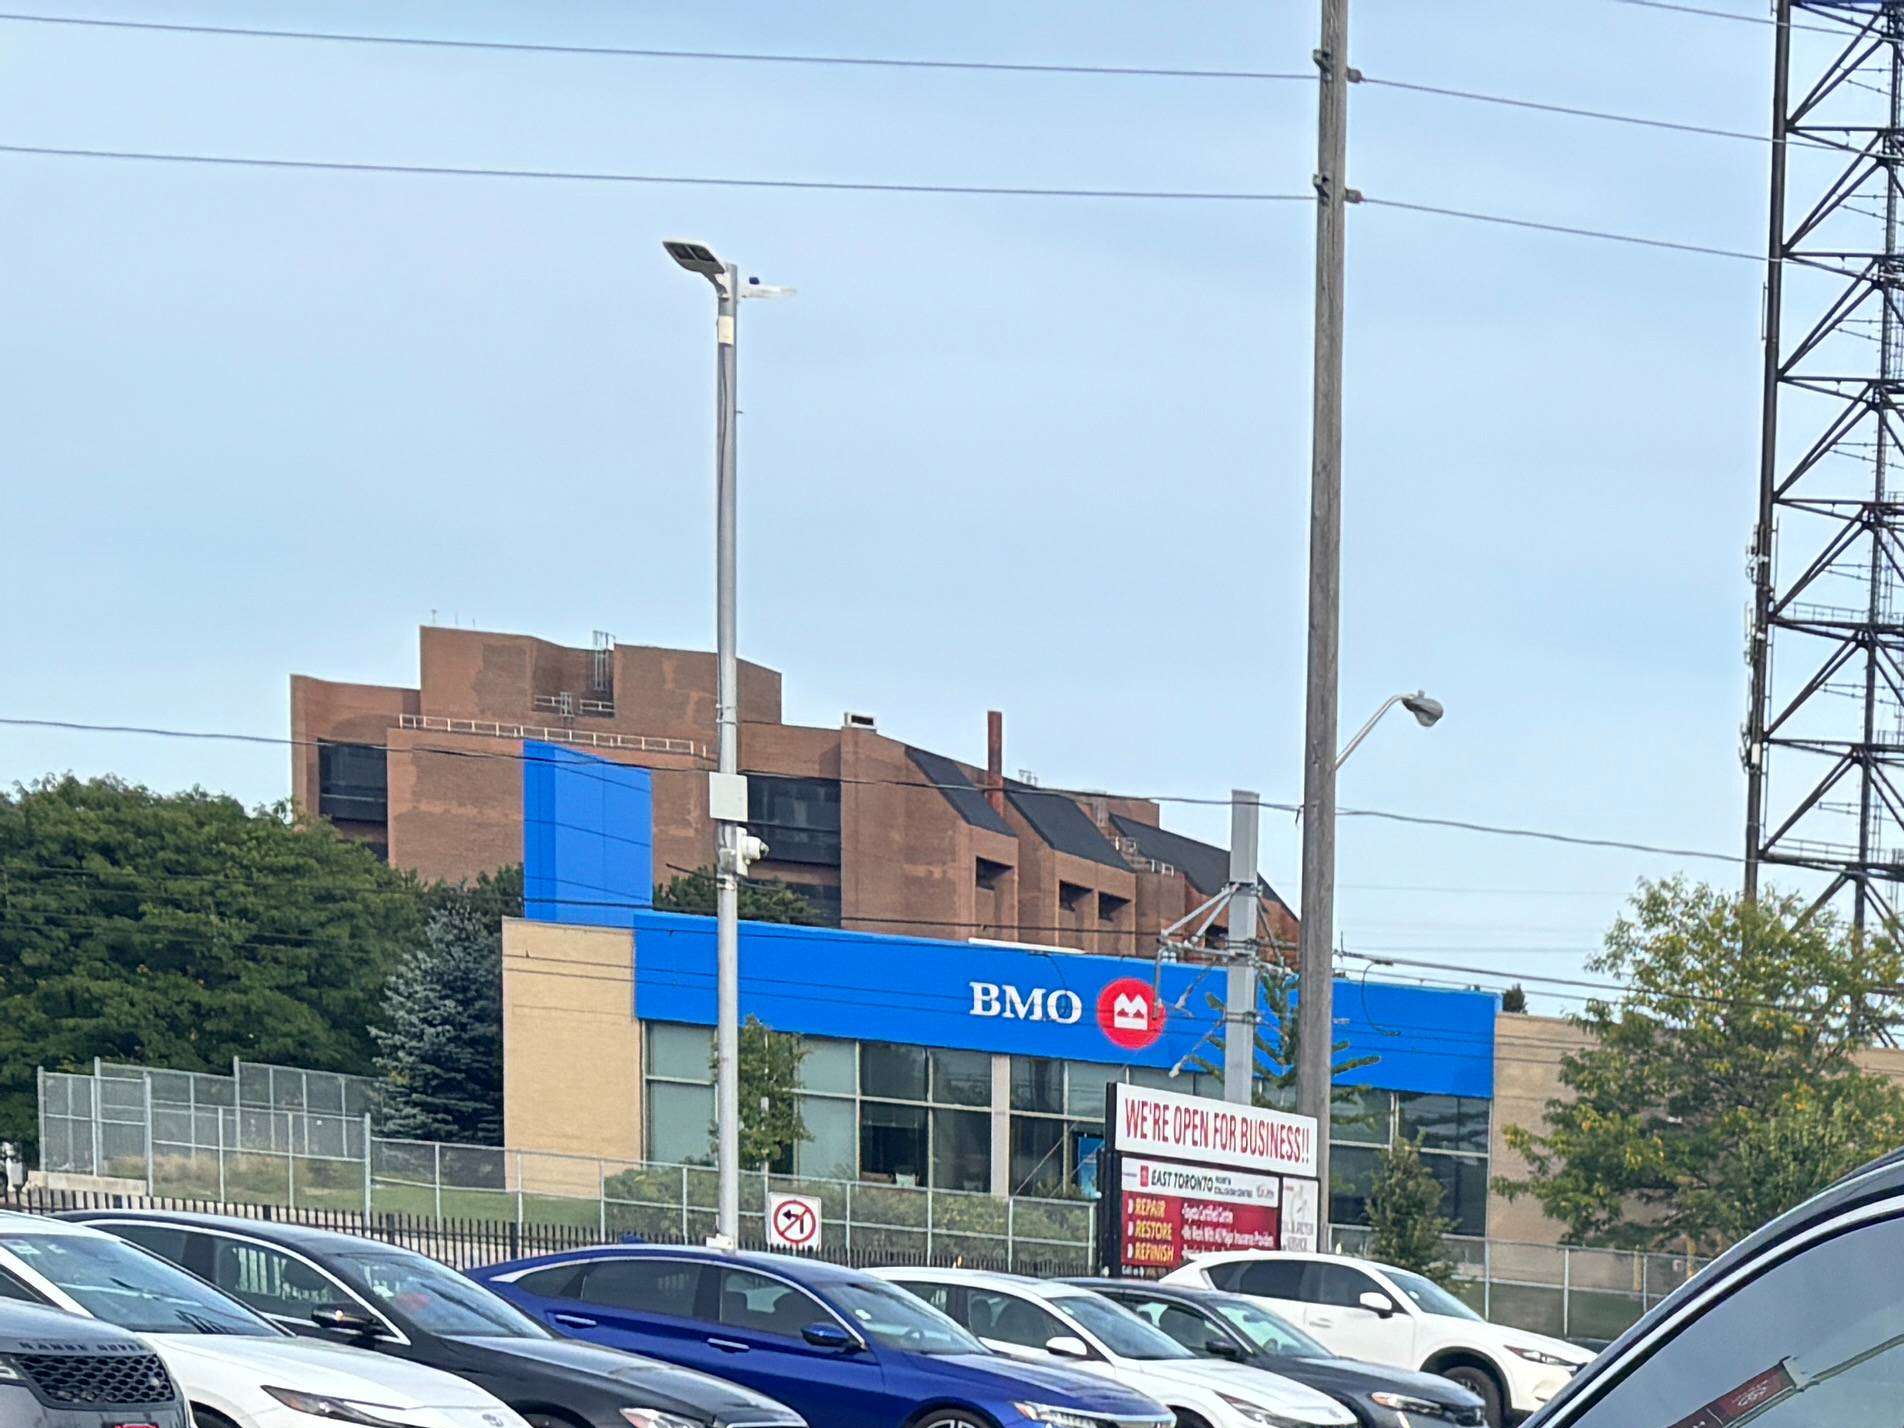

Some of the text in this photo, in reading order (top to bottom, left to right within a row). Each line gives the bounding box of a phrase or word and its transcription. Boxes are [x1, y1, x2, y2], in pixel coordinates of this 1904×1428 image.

[969, 981, 1082, 1024] BMO
[1125, 1098, 1310, 1164] WE'RE OPEN FOR BUSINESS!!
[1151, 1169, 1172, 1188] EAST
[1174, 1172, 1214, 1193] TORONTO
[1134, 1198, 1166, 1218] REPAIR
[1134, 1220, 1173, 1241] RESTORE
[1134, 1242, 1174, 1262] REFINISH
